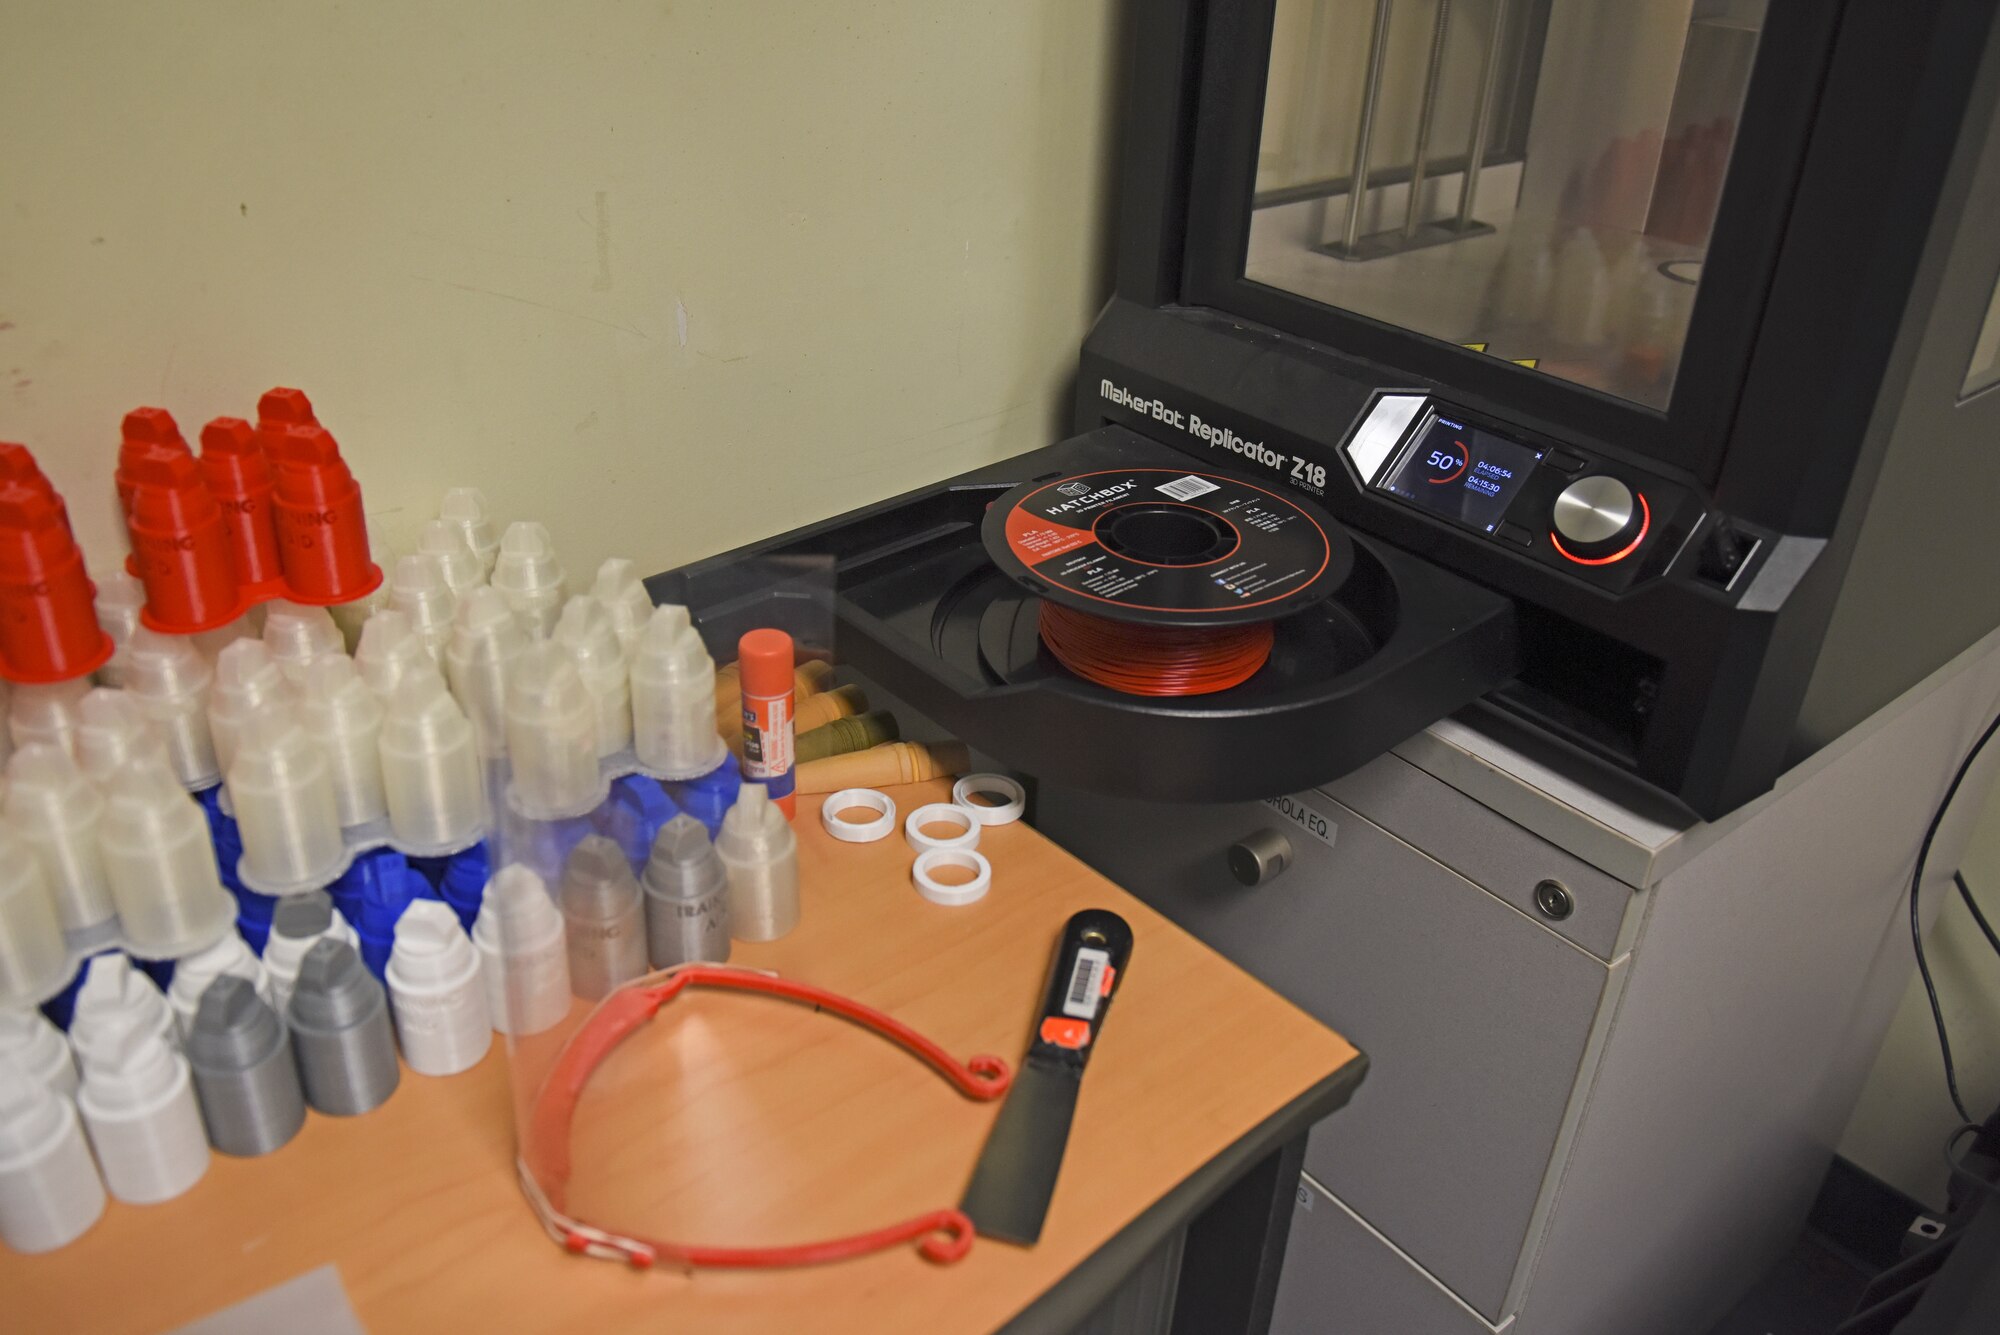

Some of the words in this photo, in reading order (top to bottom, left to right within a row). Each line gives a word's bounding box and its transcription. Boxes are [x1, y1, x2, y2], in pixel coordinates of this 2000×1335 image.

[1437, 418, 1463, 431] PRINTING
[1188, 414, 1288, 470] Replicator
[1290, 455, 1326, 488] Z18
[1473, 467, 1500, 481] ELAPSED
[1477, 461, 1513, 479] 04:06:54
[1289, 478, 1299, 487] 3D
[1299, 481, 1325, 498] PRINTER
[1464, 482, 1496, 498] REMAINING
[1467, 475, 1501, 493] 04:15:30
[1045, 480, 1137, 515] HATCHBOX
[1308, 813, 1329, 840] EQ.
